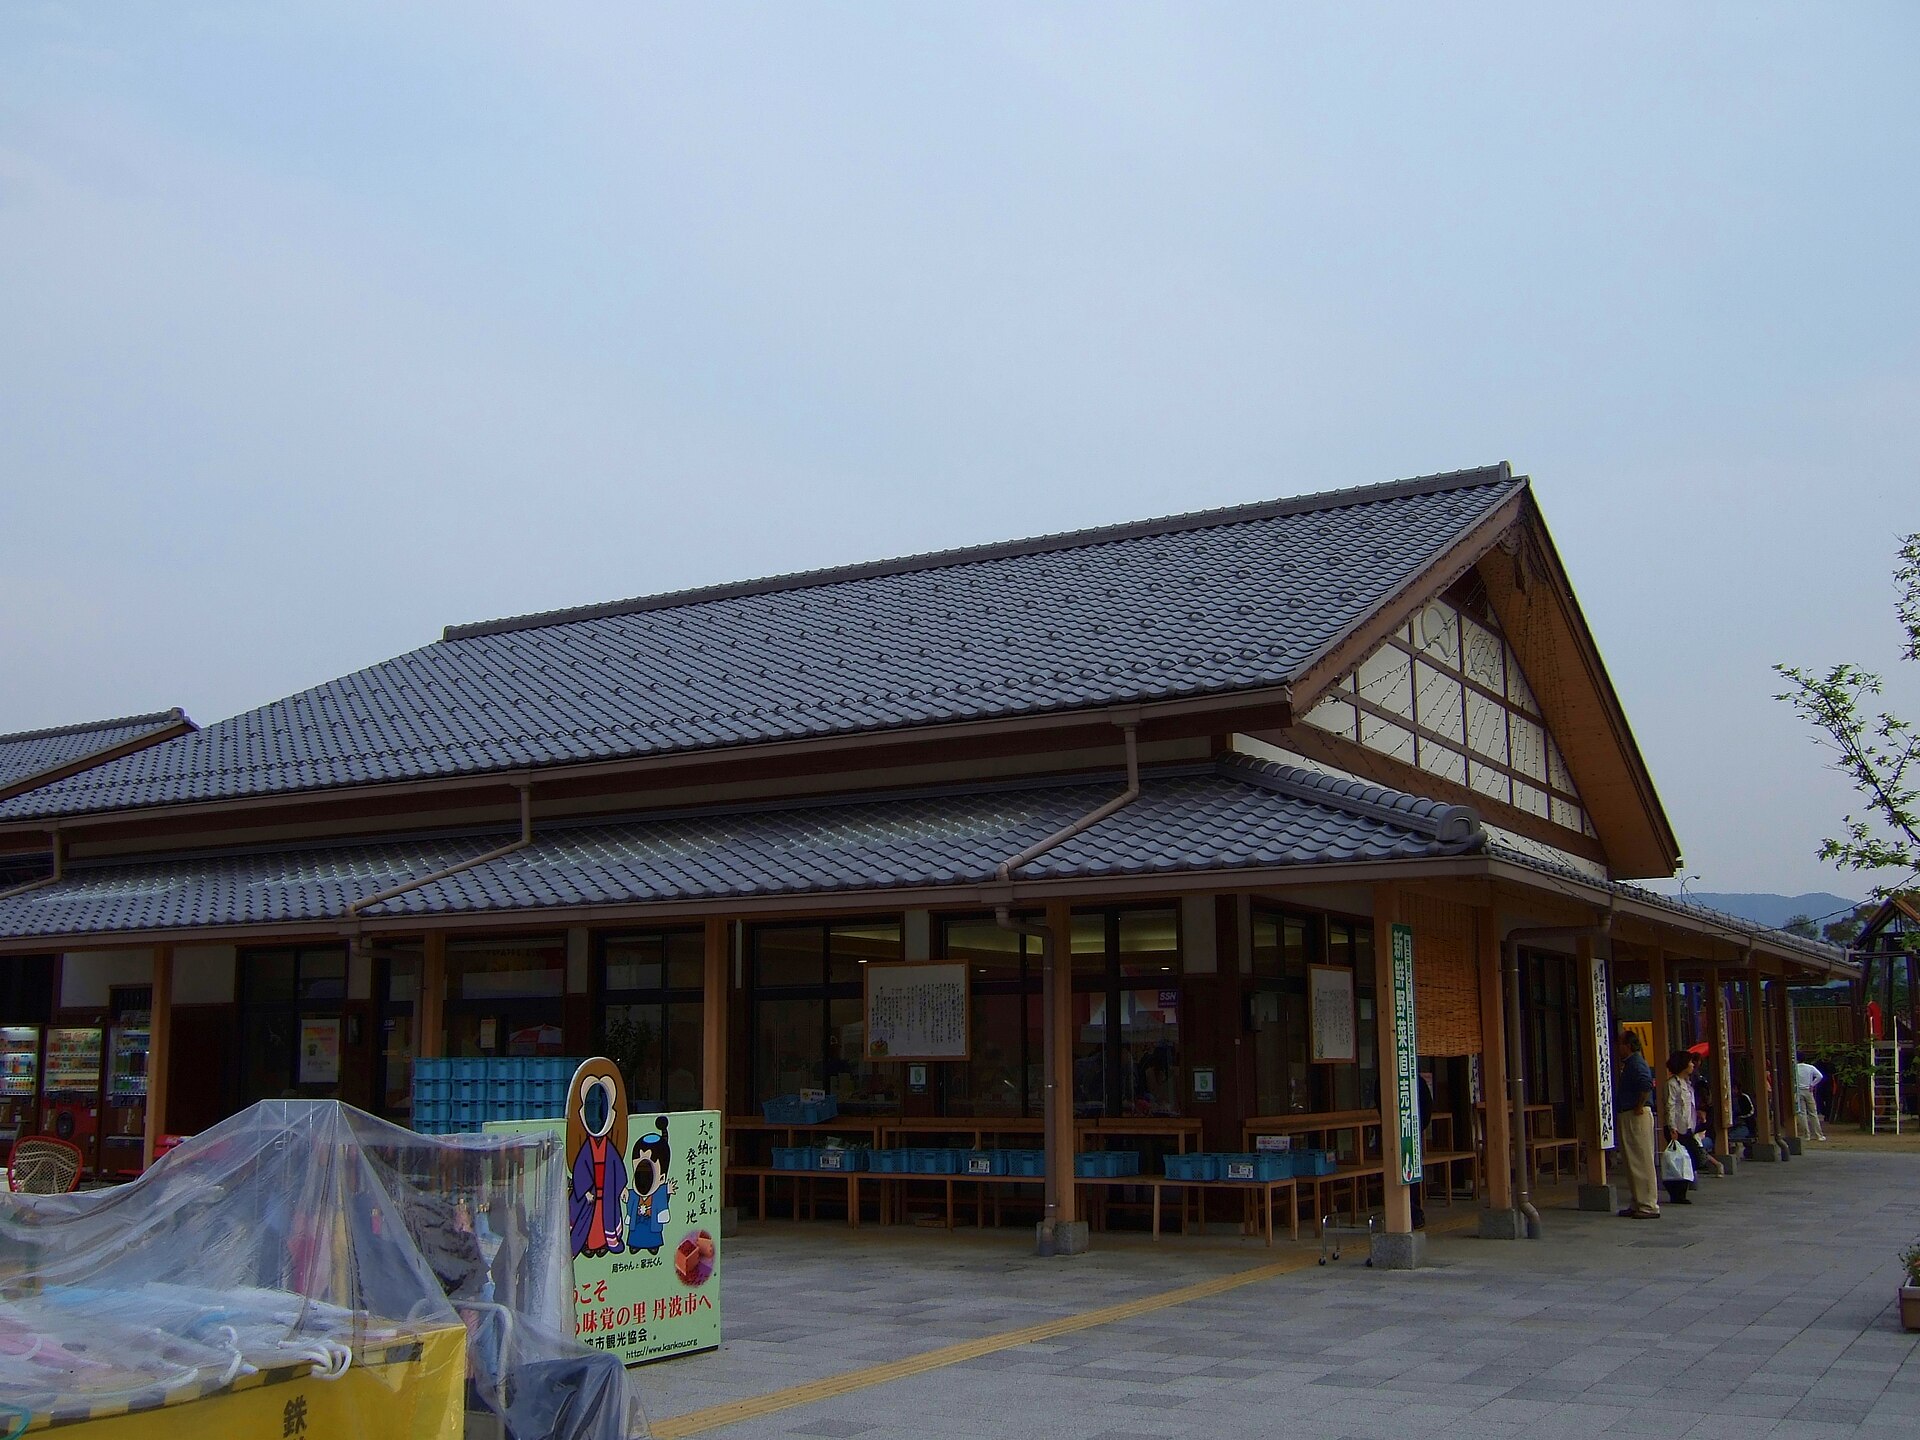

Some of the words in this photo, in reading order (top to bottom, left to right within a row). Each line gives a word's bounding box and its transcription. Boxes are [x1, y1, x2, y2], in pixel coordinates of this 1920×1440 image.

[685, 1147, 698, 1225] 発祥の地
[698, 1119, 709, 1215] 大納言小豆
[652, 1293, 712, 1321] 丹波市へ
[283, 1395, 307, 1440] 鉄
